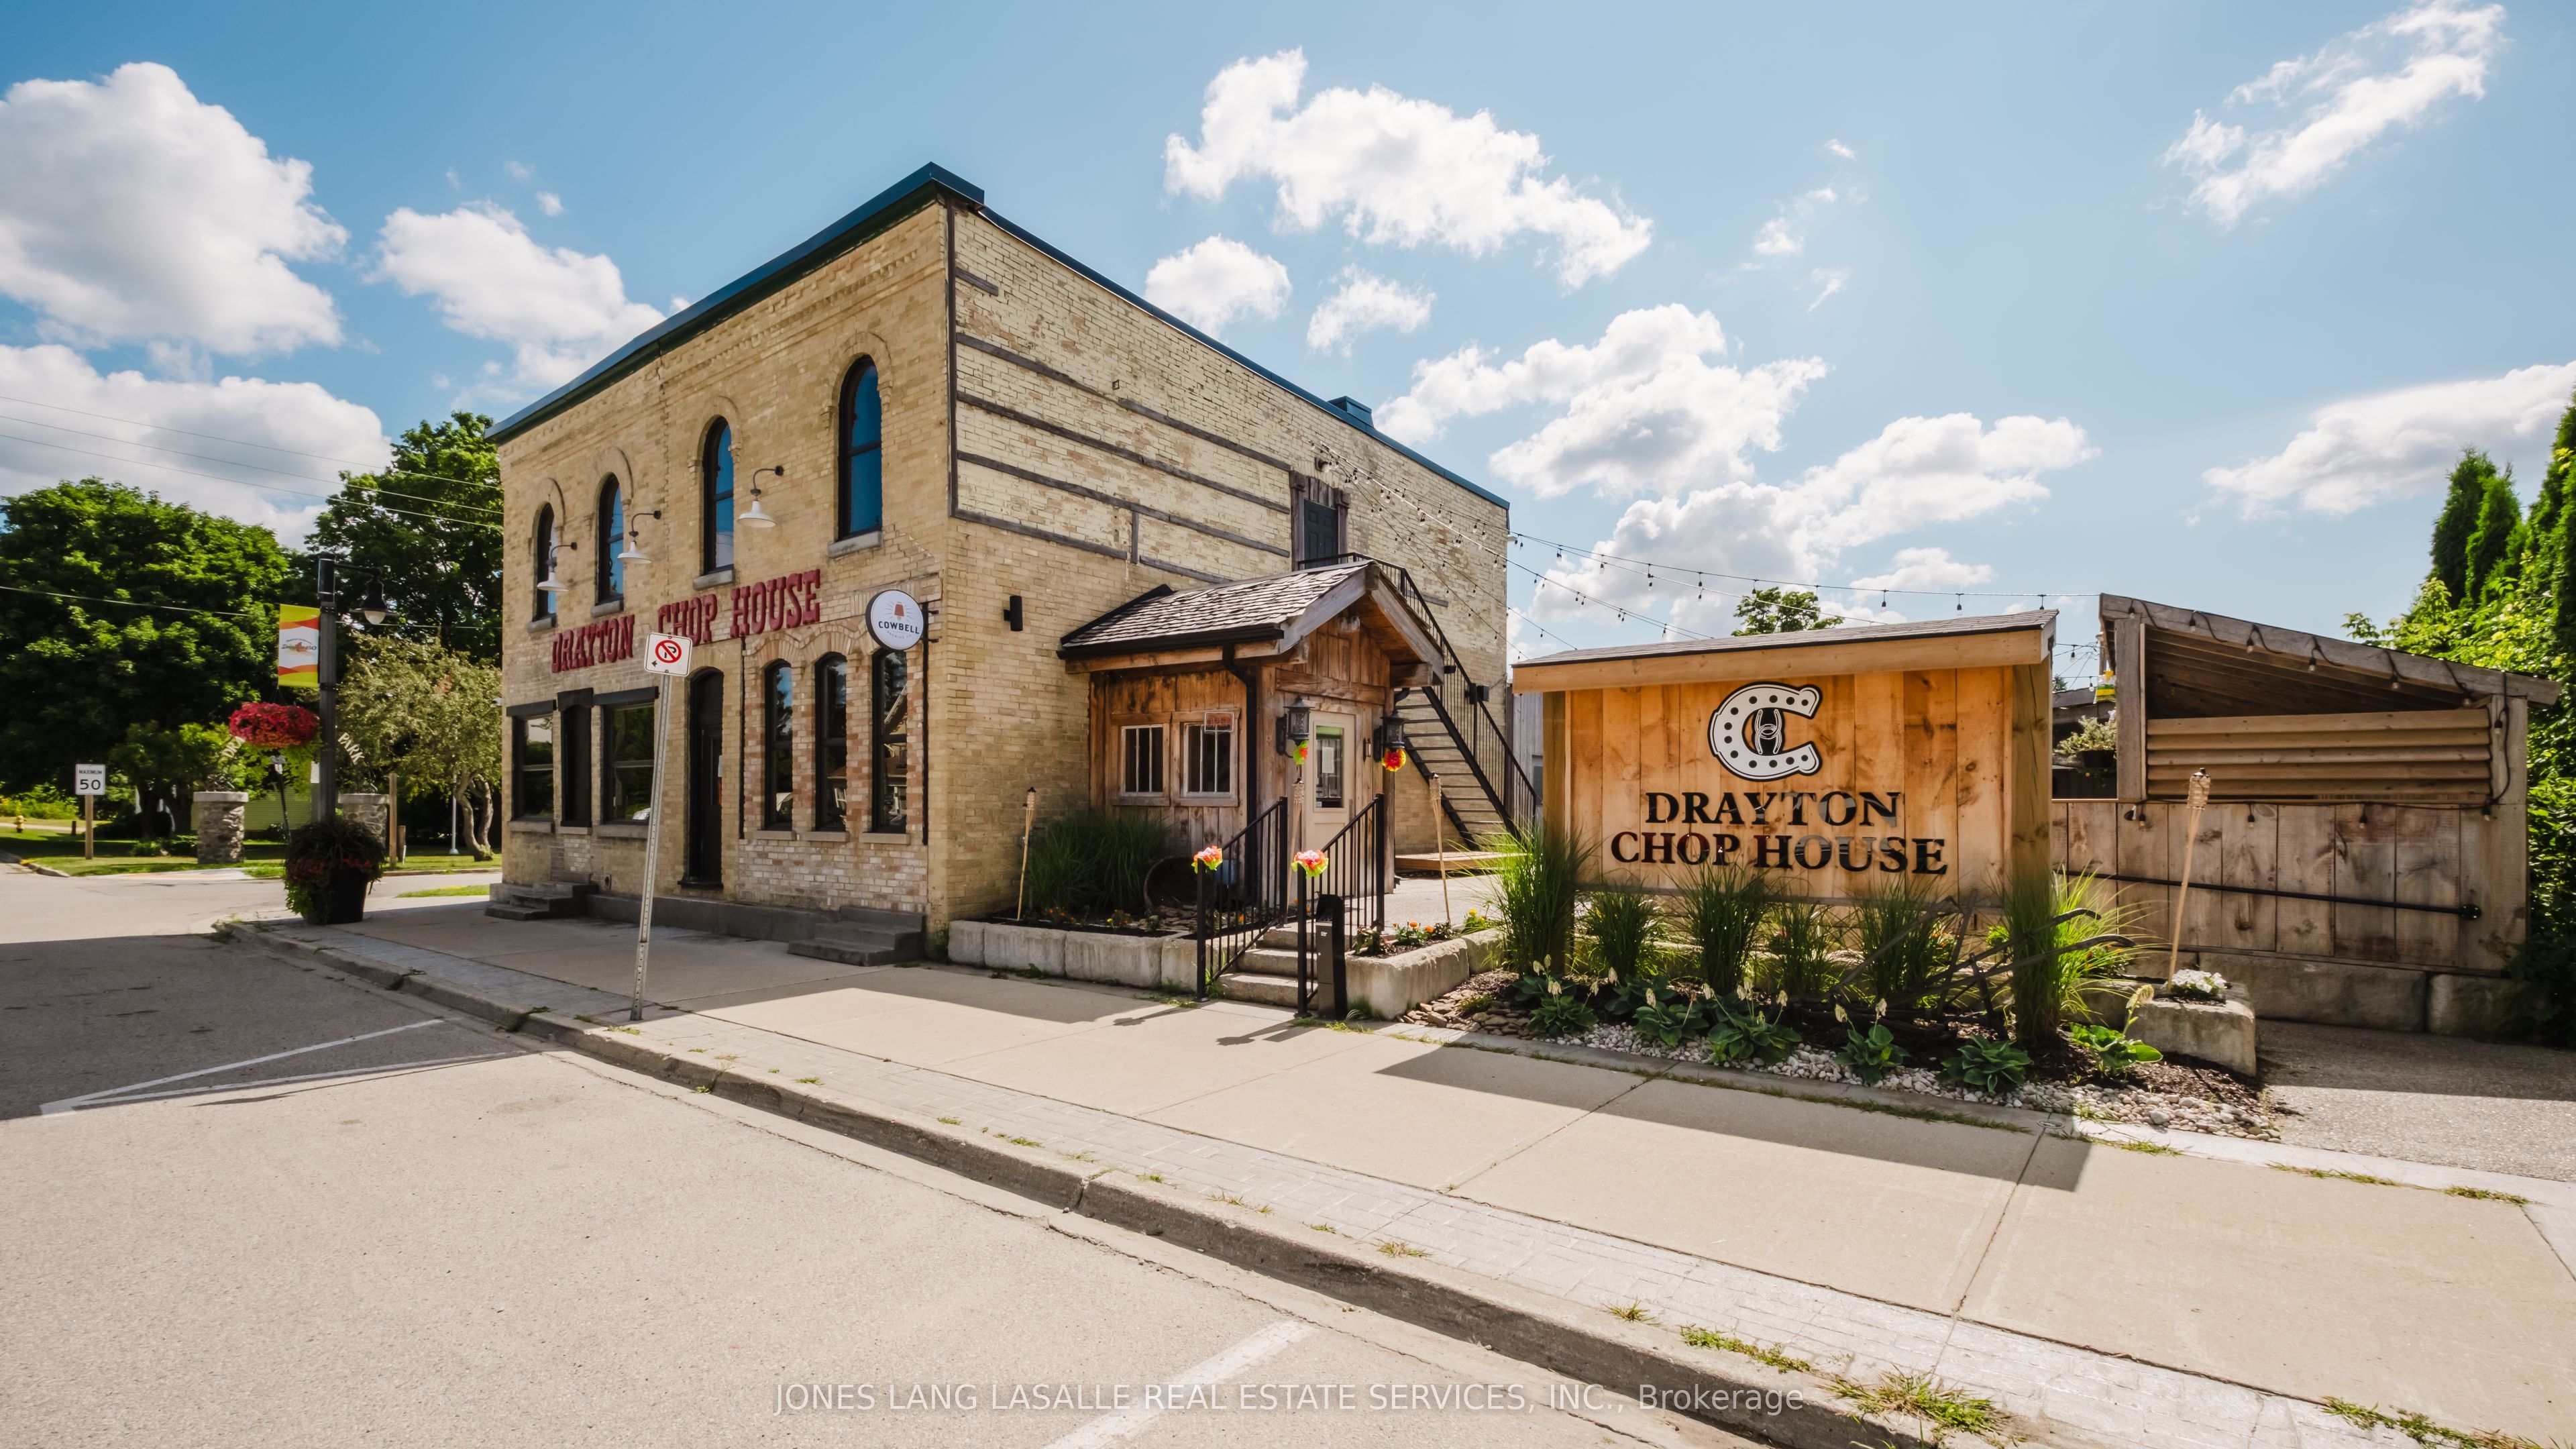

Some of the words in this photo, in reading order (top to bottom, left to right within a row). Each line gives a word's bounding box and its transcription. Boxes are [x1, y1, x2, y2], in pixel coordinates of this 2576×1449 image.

[551, 614, 635, 674] DRAYTON
[657, 594, 718, 647] CHOP
[730, 569, 820, 638] HOUSE
[878, 621, 920, 635] COWBELL
[337, 732, 365, 765] PARK
[80, 779, 101, 790] 50
[1645, 791, 1902, 827] DRAYTON
[1611, 831, 1740, 866] CHOP
[1754, 835, 1948, 875] HOUSE
